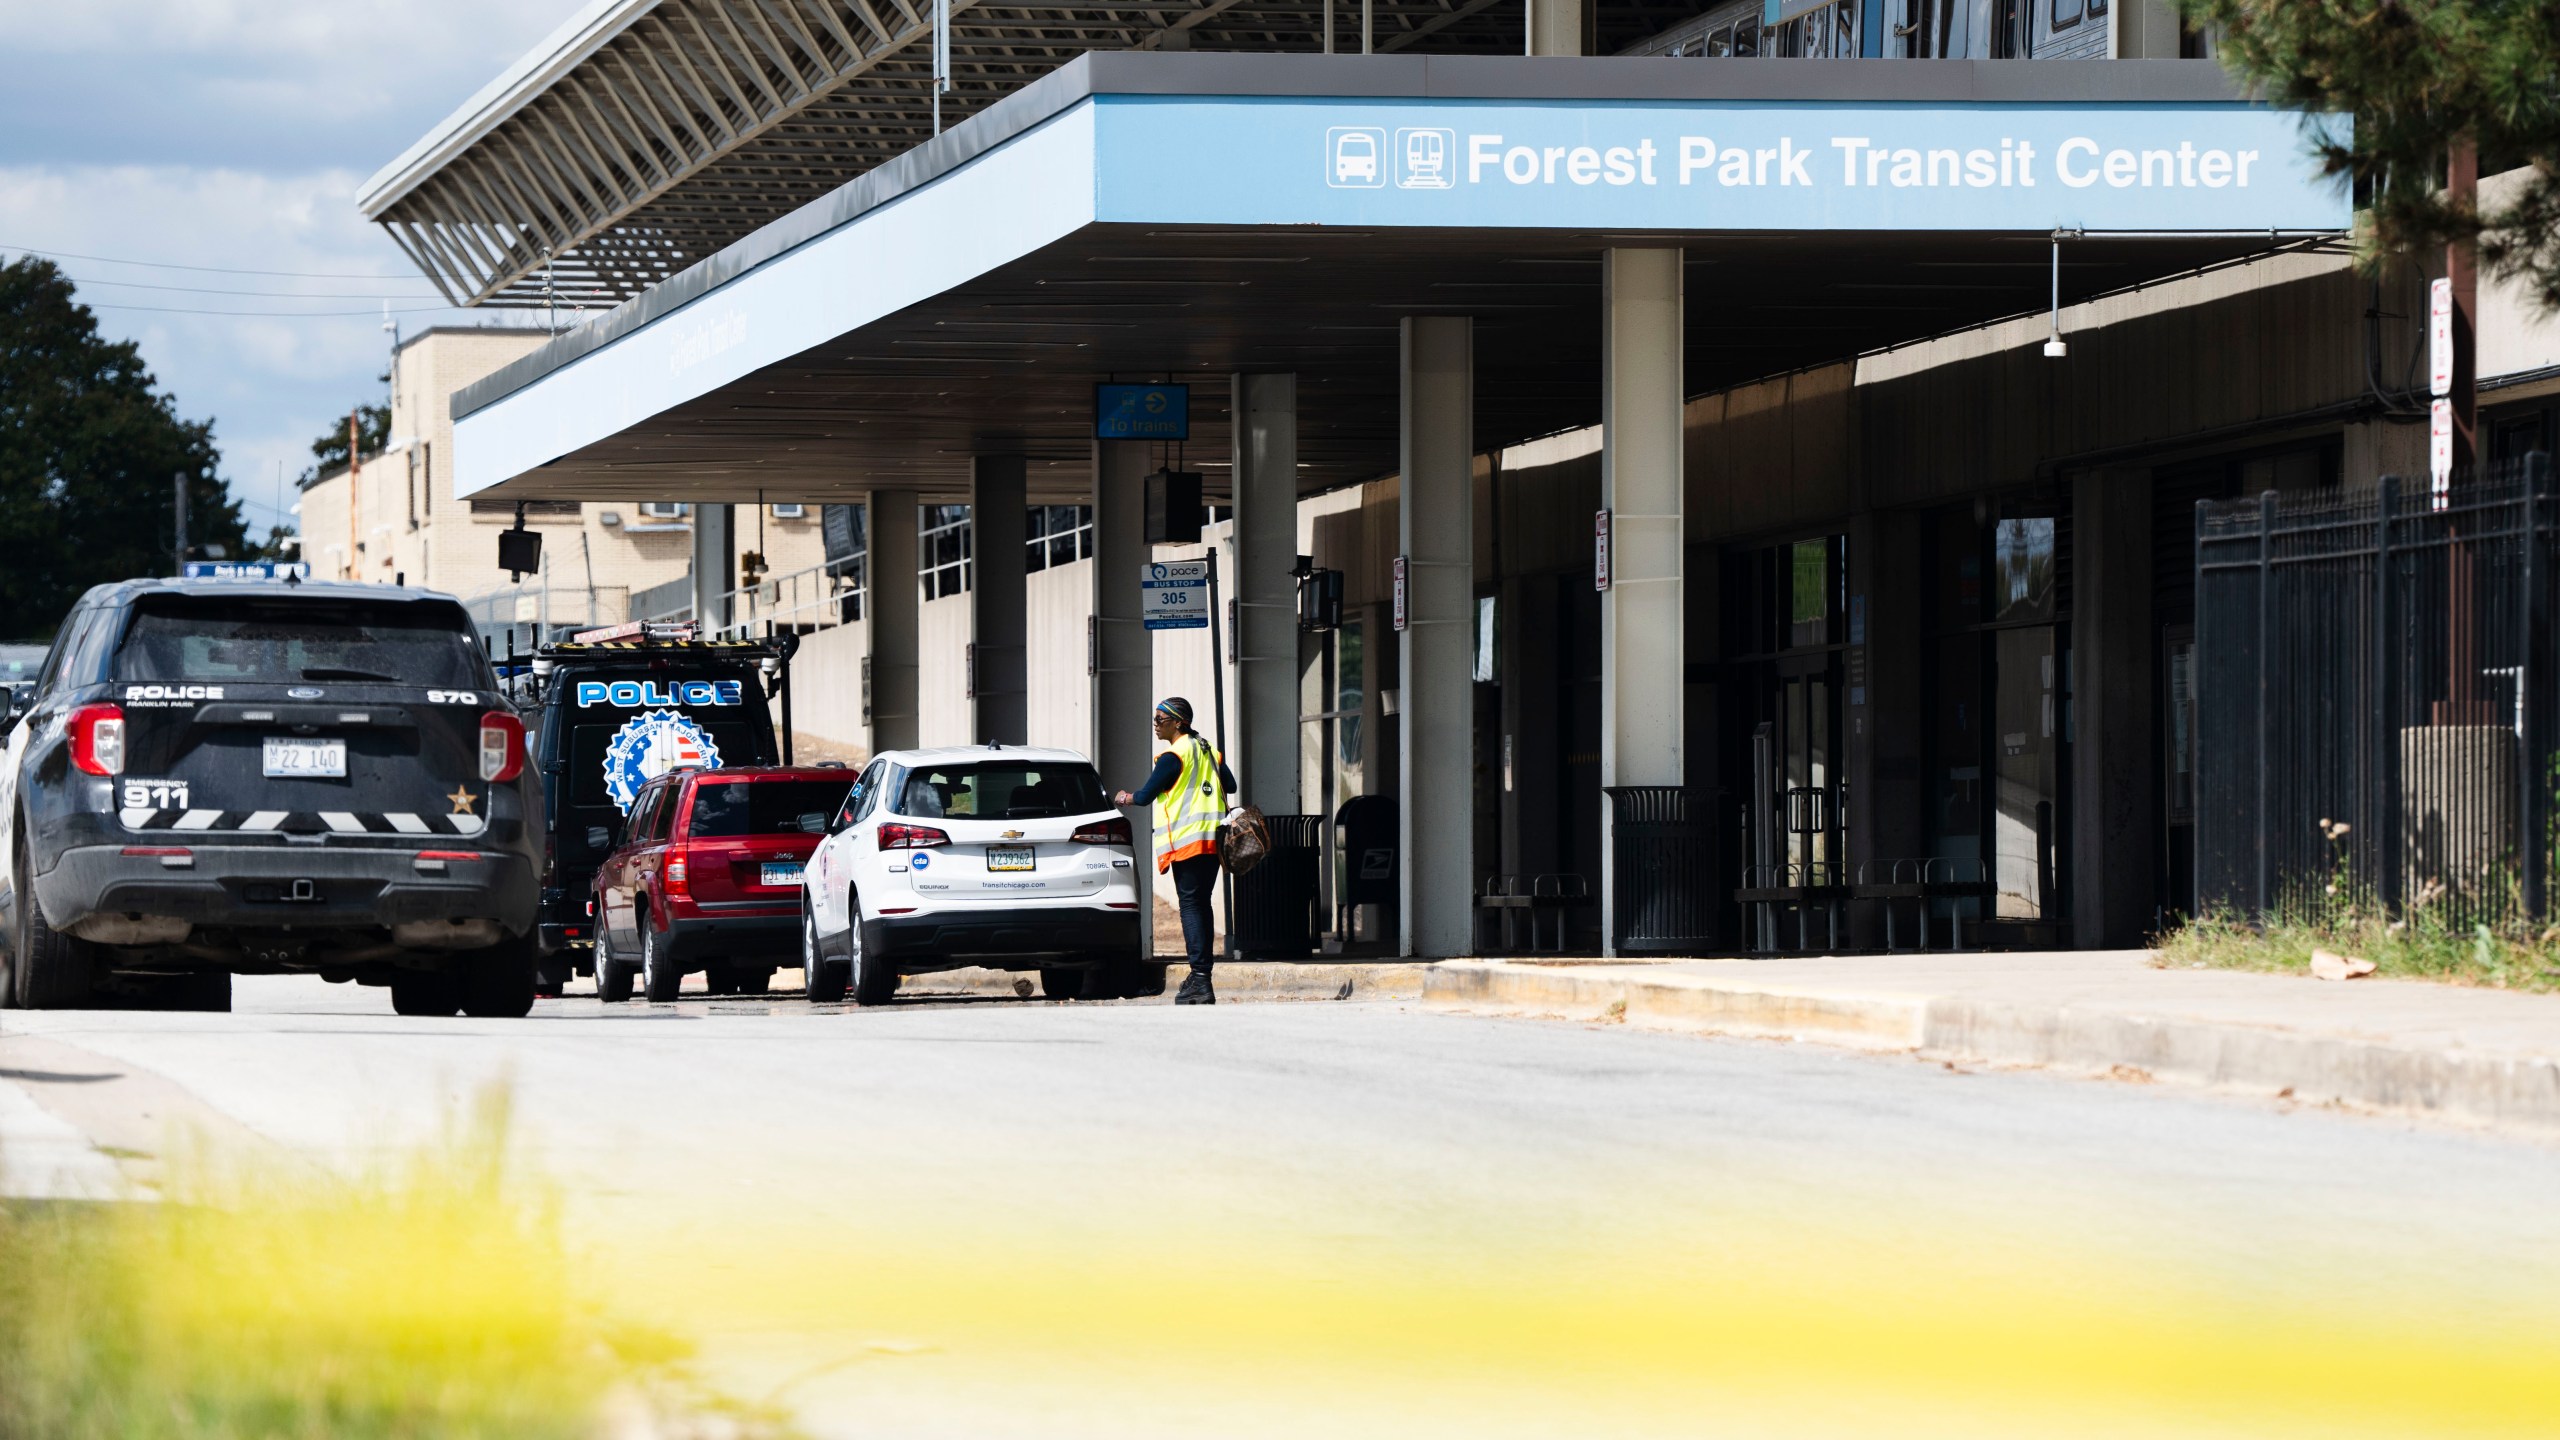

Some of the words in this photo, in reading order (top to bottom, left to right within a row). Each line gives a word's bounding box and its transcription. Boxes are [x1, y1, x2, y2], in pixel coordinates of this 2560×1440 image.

[1469, 135, 1656, 185] Forest
[1680, 137, 1812, 186] Park
[1832, 138, 2035, 187] Transit
[2057, 137, 2258, 187] Center
[1109, 417, 1128, 433] To
[1132, 417, 1178, 433] trains
[1171, 567, 1198, 577] pace
[1162, 592, 1187, 605] 305
[125, 686, 225, 700] POLICE
[426, 690, 479, 705] 870
[577, 680, 742, 707] POLICE
[620, 722, 663, 755] SUBURBAN
[668, 722, 699, 744] MAJOR
[281, 749, 300, 769] 22
[309, 749, 338, 769] 140
[616, 757, 625, 782] WEST
[124, 780, 188, 788] EMERGENCY
[123, 787, 189, 810] 911
[773, 851, 794, 860] Jeep
[913, 858, 928, 866] cta
[982, 881, 1046, 890] transitchicago.com
